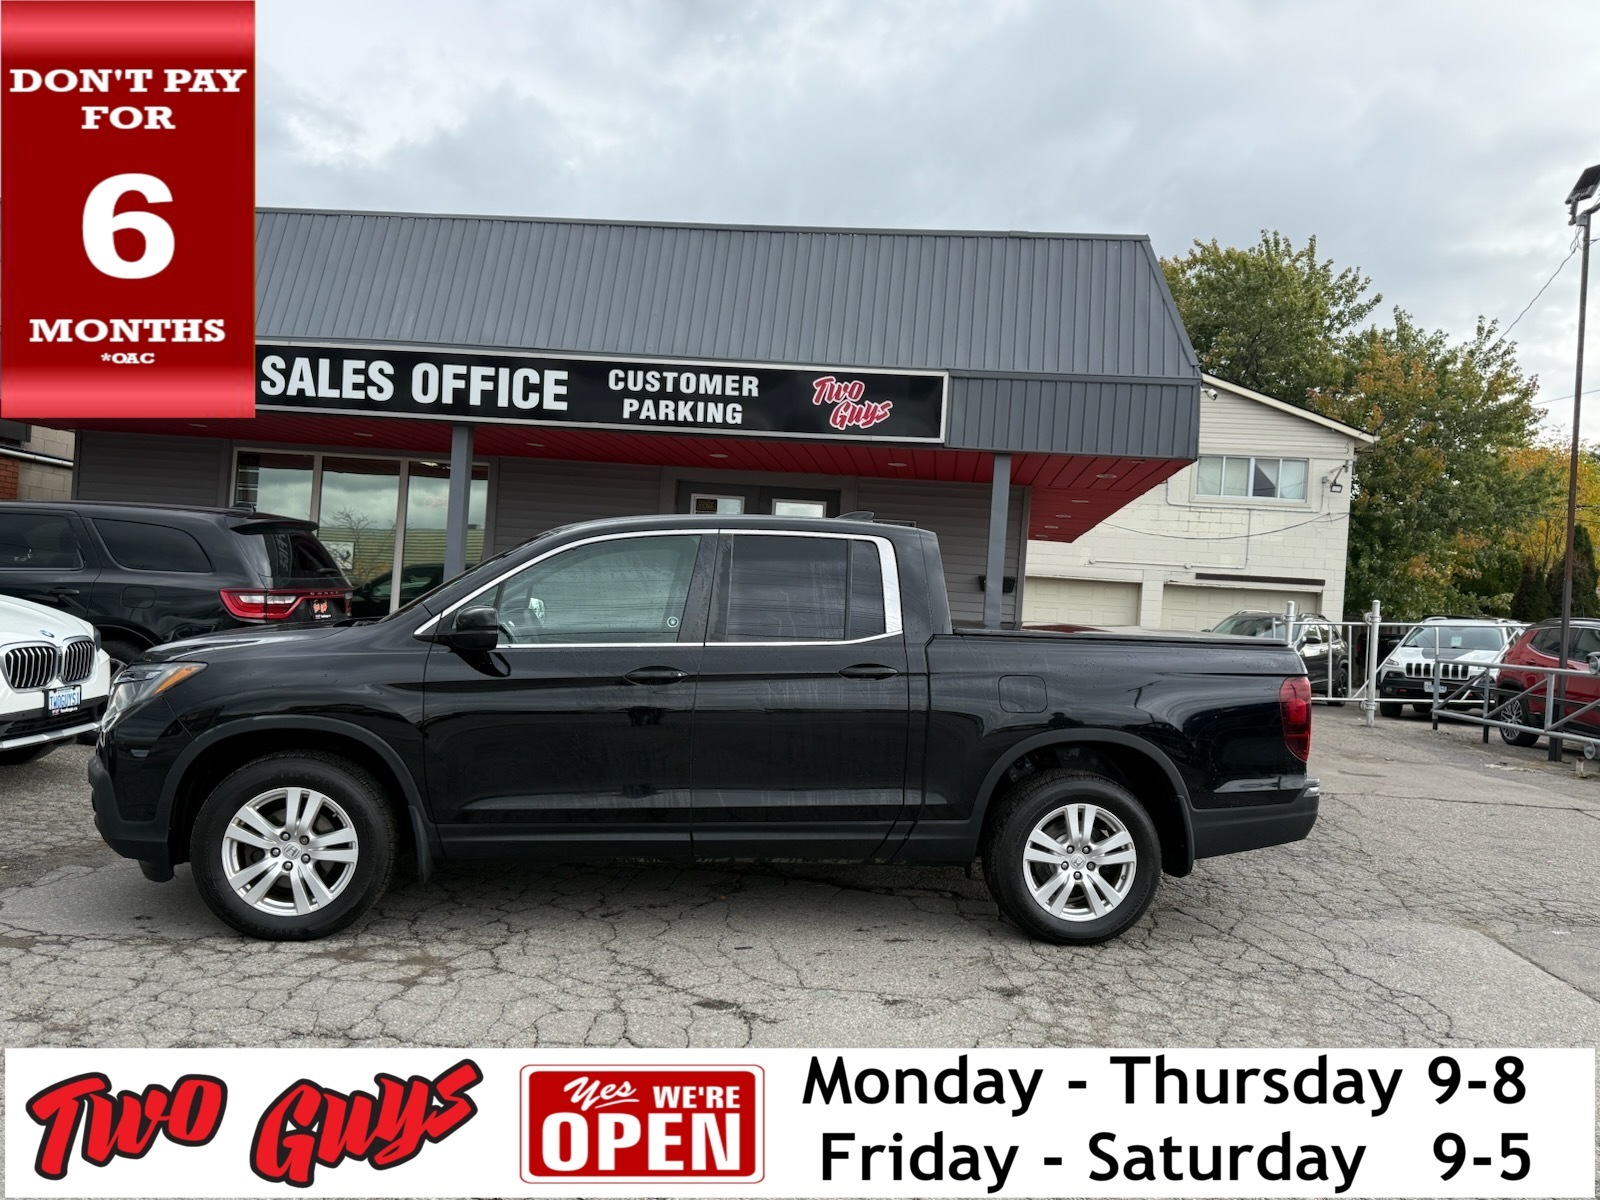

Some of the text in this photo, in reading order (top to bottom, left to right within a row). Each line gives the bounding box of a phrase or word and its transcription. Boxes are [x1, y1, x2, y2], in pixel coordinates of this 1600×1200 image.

[260, 355, 569, 411] SALES OFFICE
[608, 368, 760, 398] CUSTOMER
[812, 376, 865, 406] Two
[622, 398, 743, 425] PARKING
[829, 400, 893, 430] Guys
